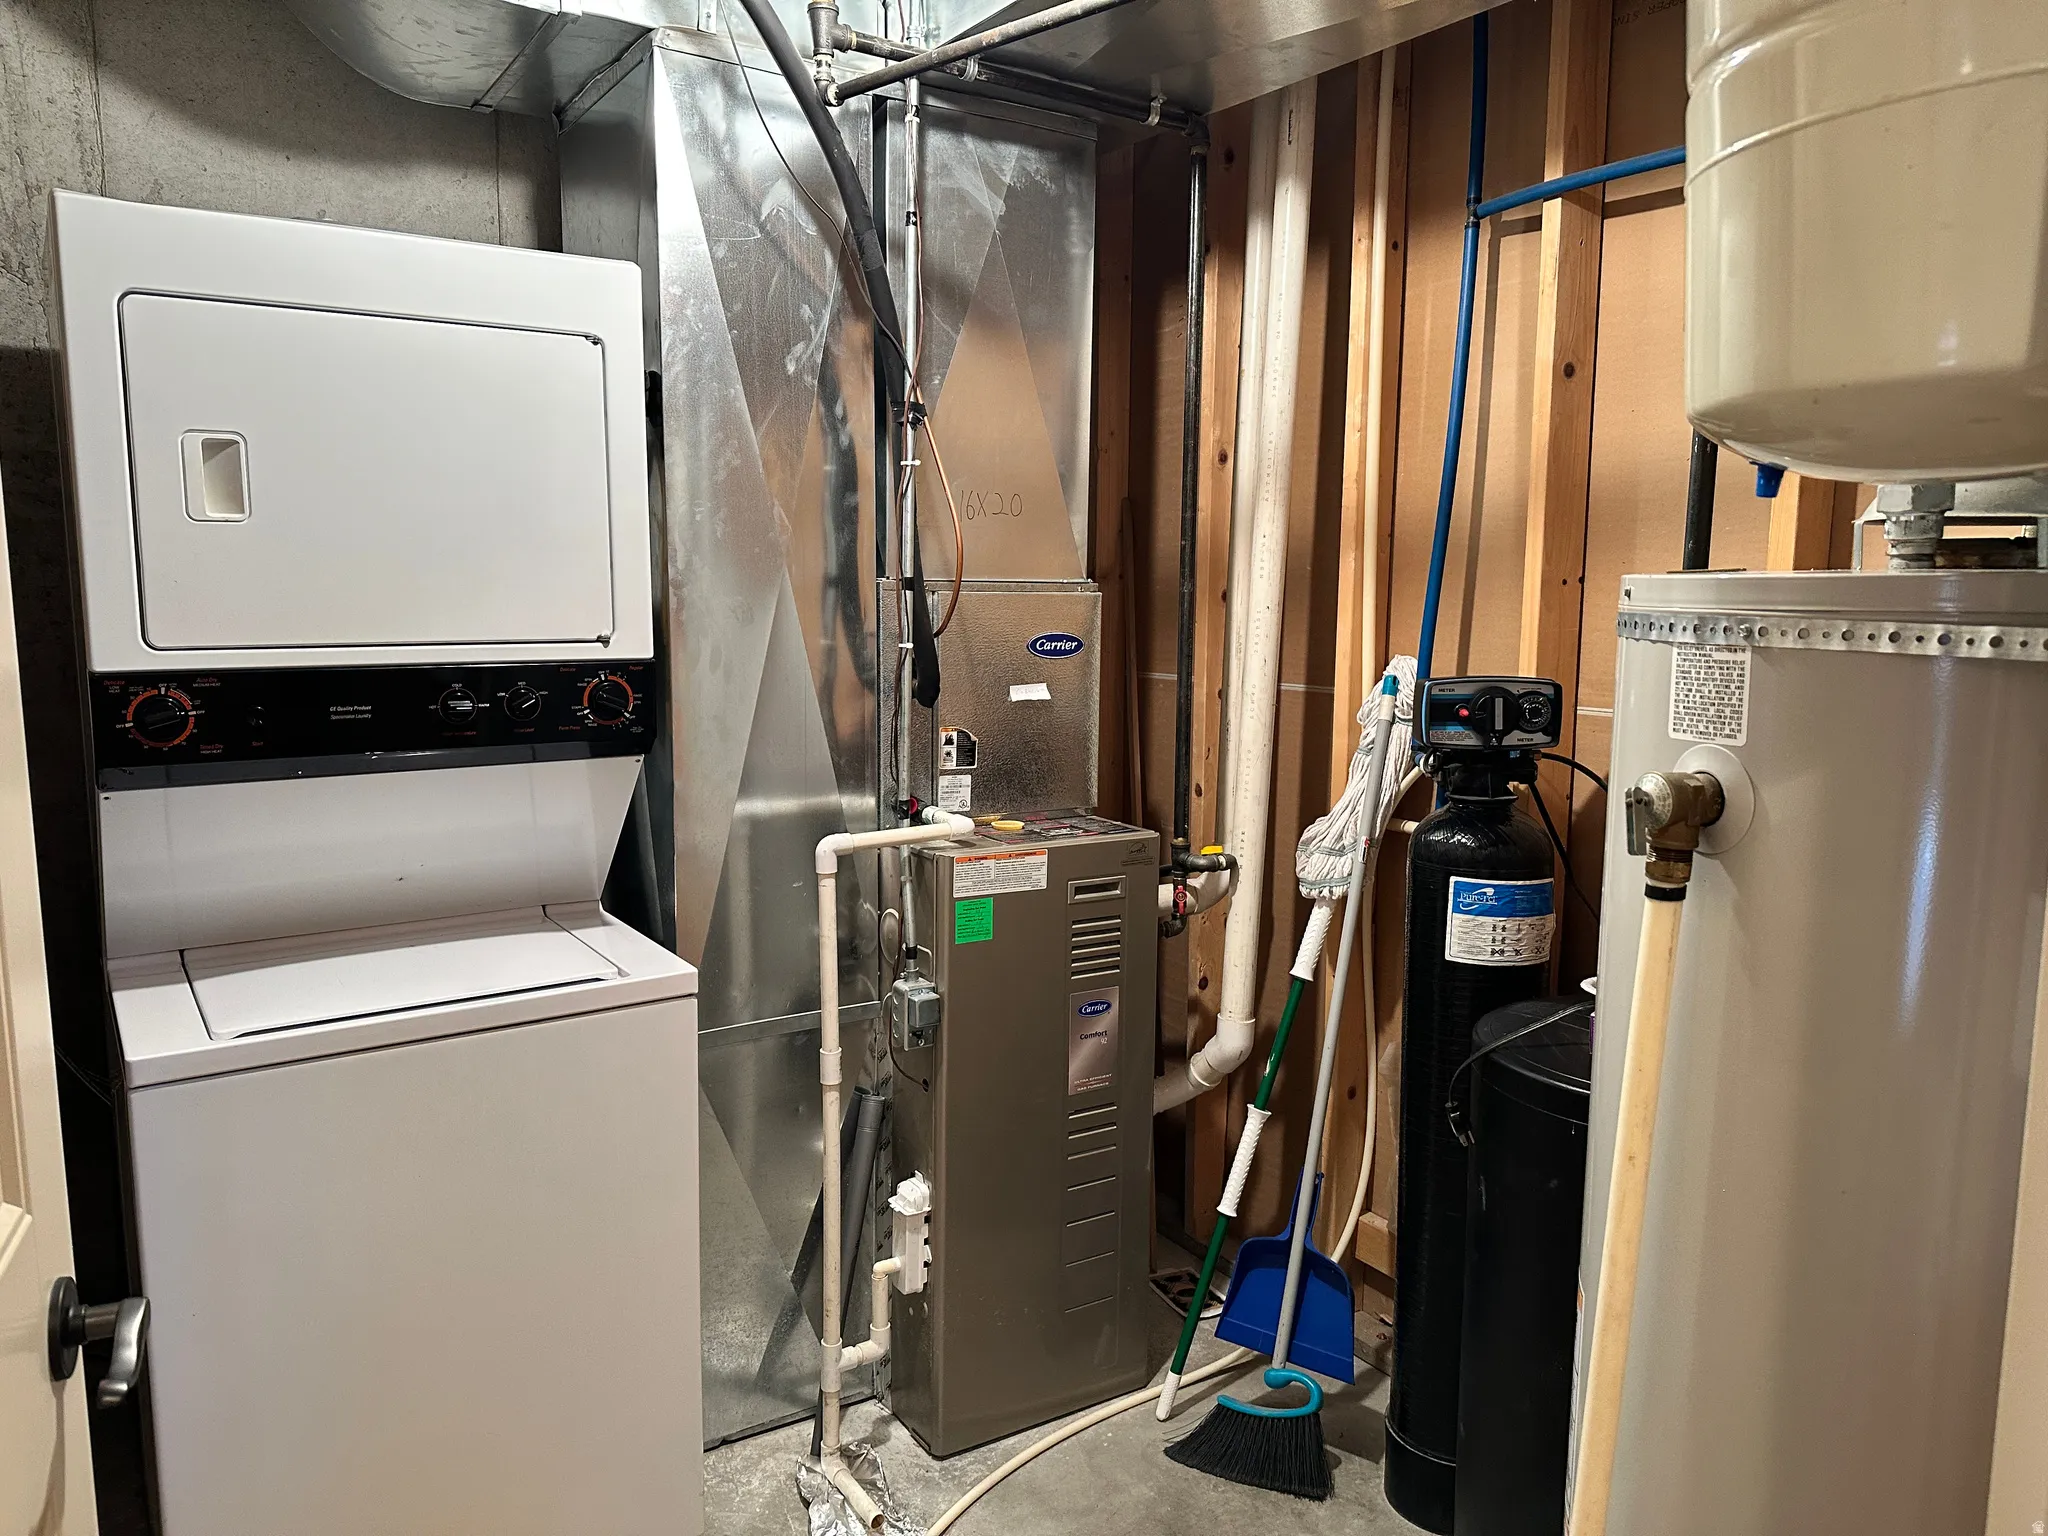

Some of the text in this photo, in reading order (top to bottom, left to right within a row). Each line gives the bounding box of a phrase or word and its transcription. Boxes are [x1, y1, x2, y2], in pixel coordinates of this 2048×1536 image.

[1035, 639, 1078, 651] Carrier
[1082, 1003, 1108, 1013] Carrier
[1080, 1030, 1107, 1040] Comfort
